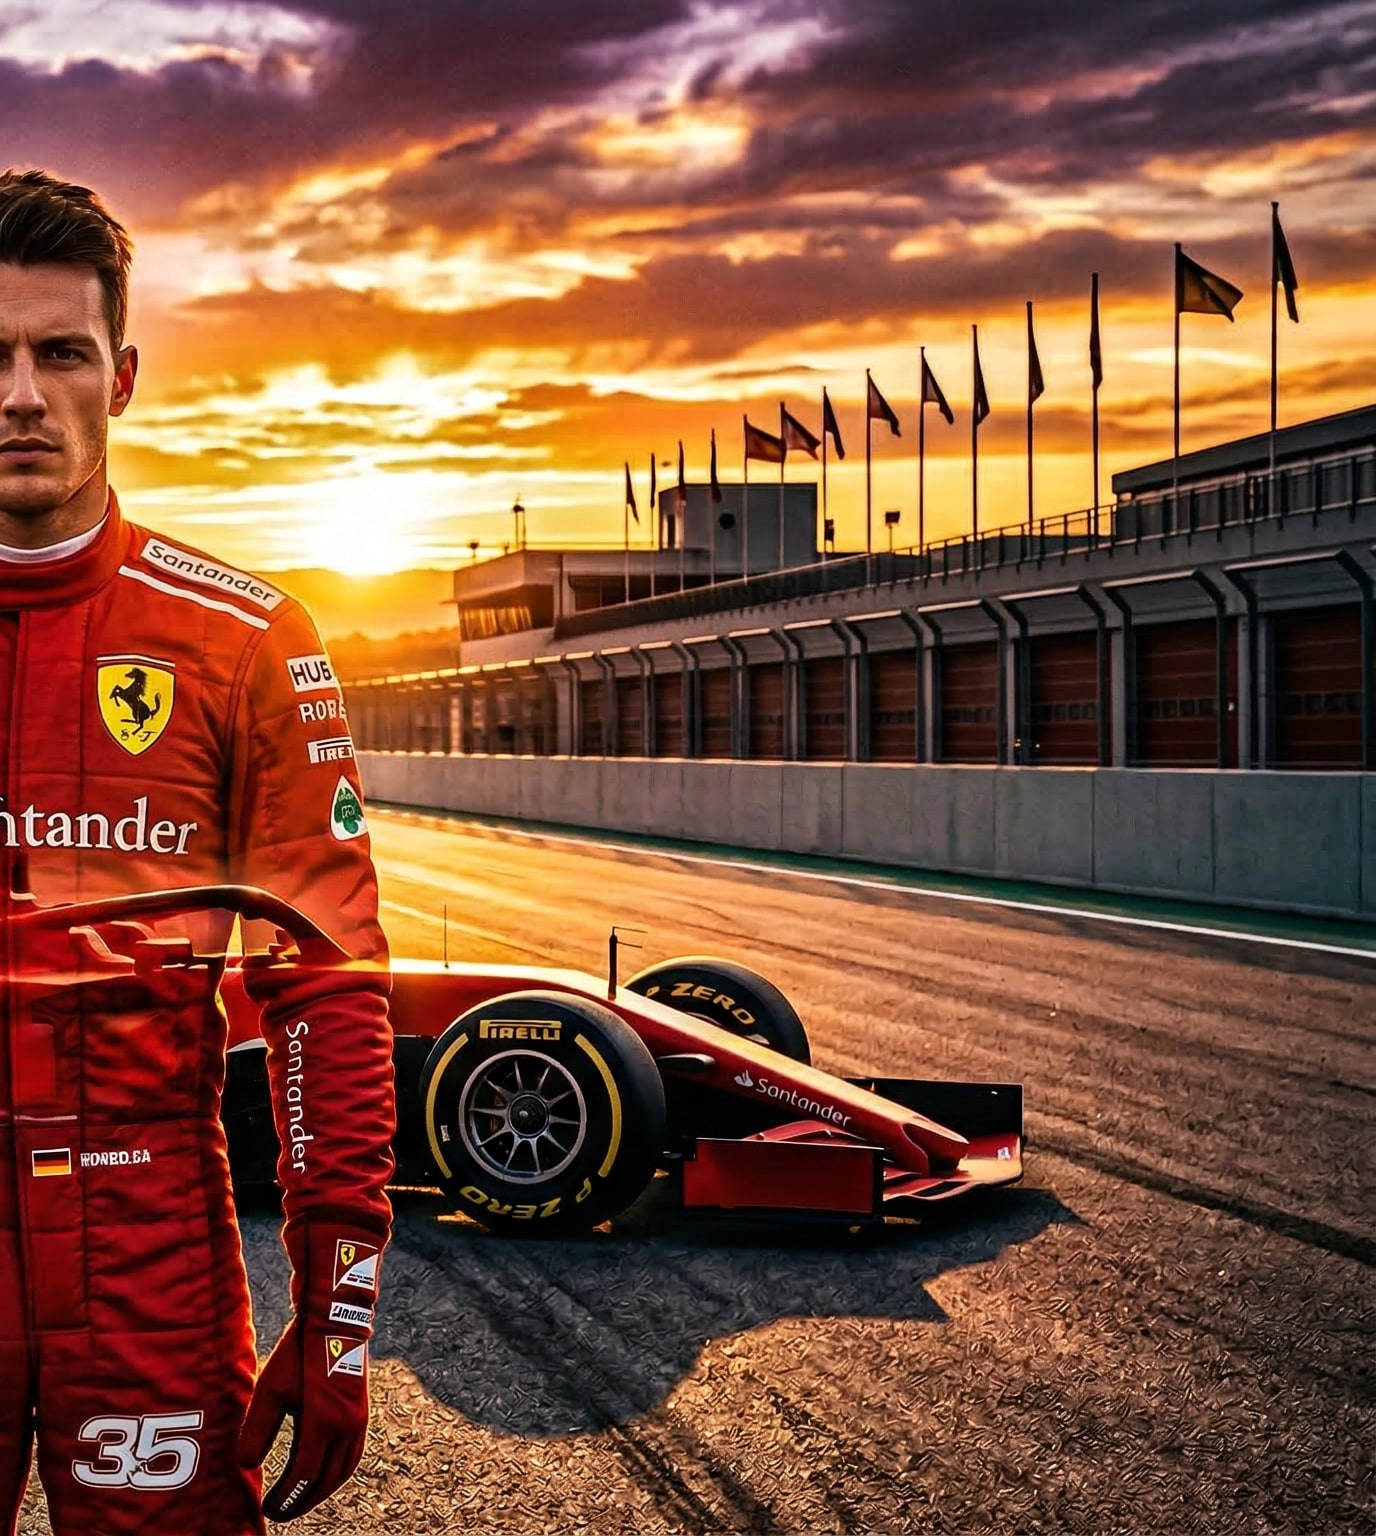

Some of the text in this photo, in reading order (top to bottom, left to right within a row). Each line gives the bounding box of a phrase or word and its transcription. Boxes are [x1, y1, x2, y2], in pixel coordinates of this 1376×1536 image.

[148, 544, 276, 602] Santander
[670, 982, 756, 1025] ZERO
[479, 1019, 562, 1041] PIRELLI
[285, 1021, 314, 1174] Santander
[755, 1078, 852, 1127] Santander
[459, 1185, 562, 1220] ZERO
[72, 1410, 204, 1491] 35
